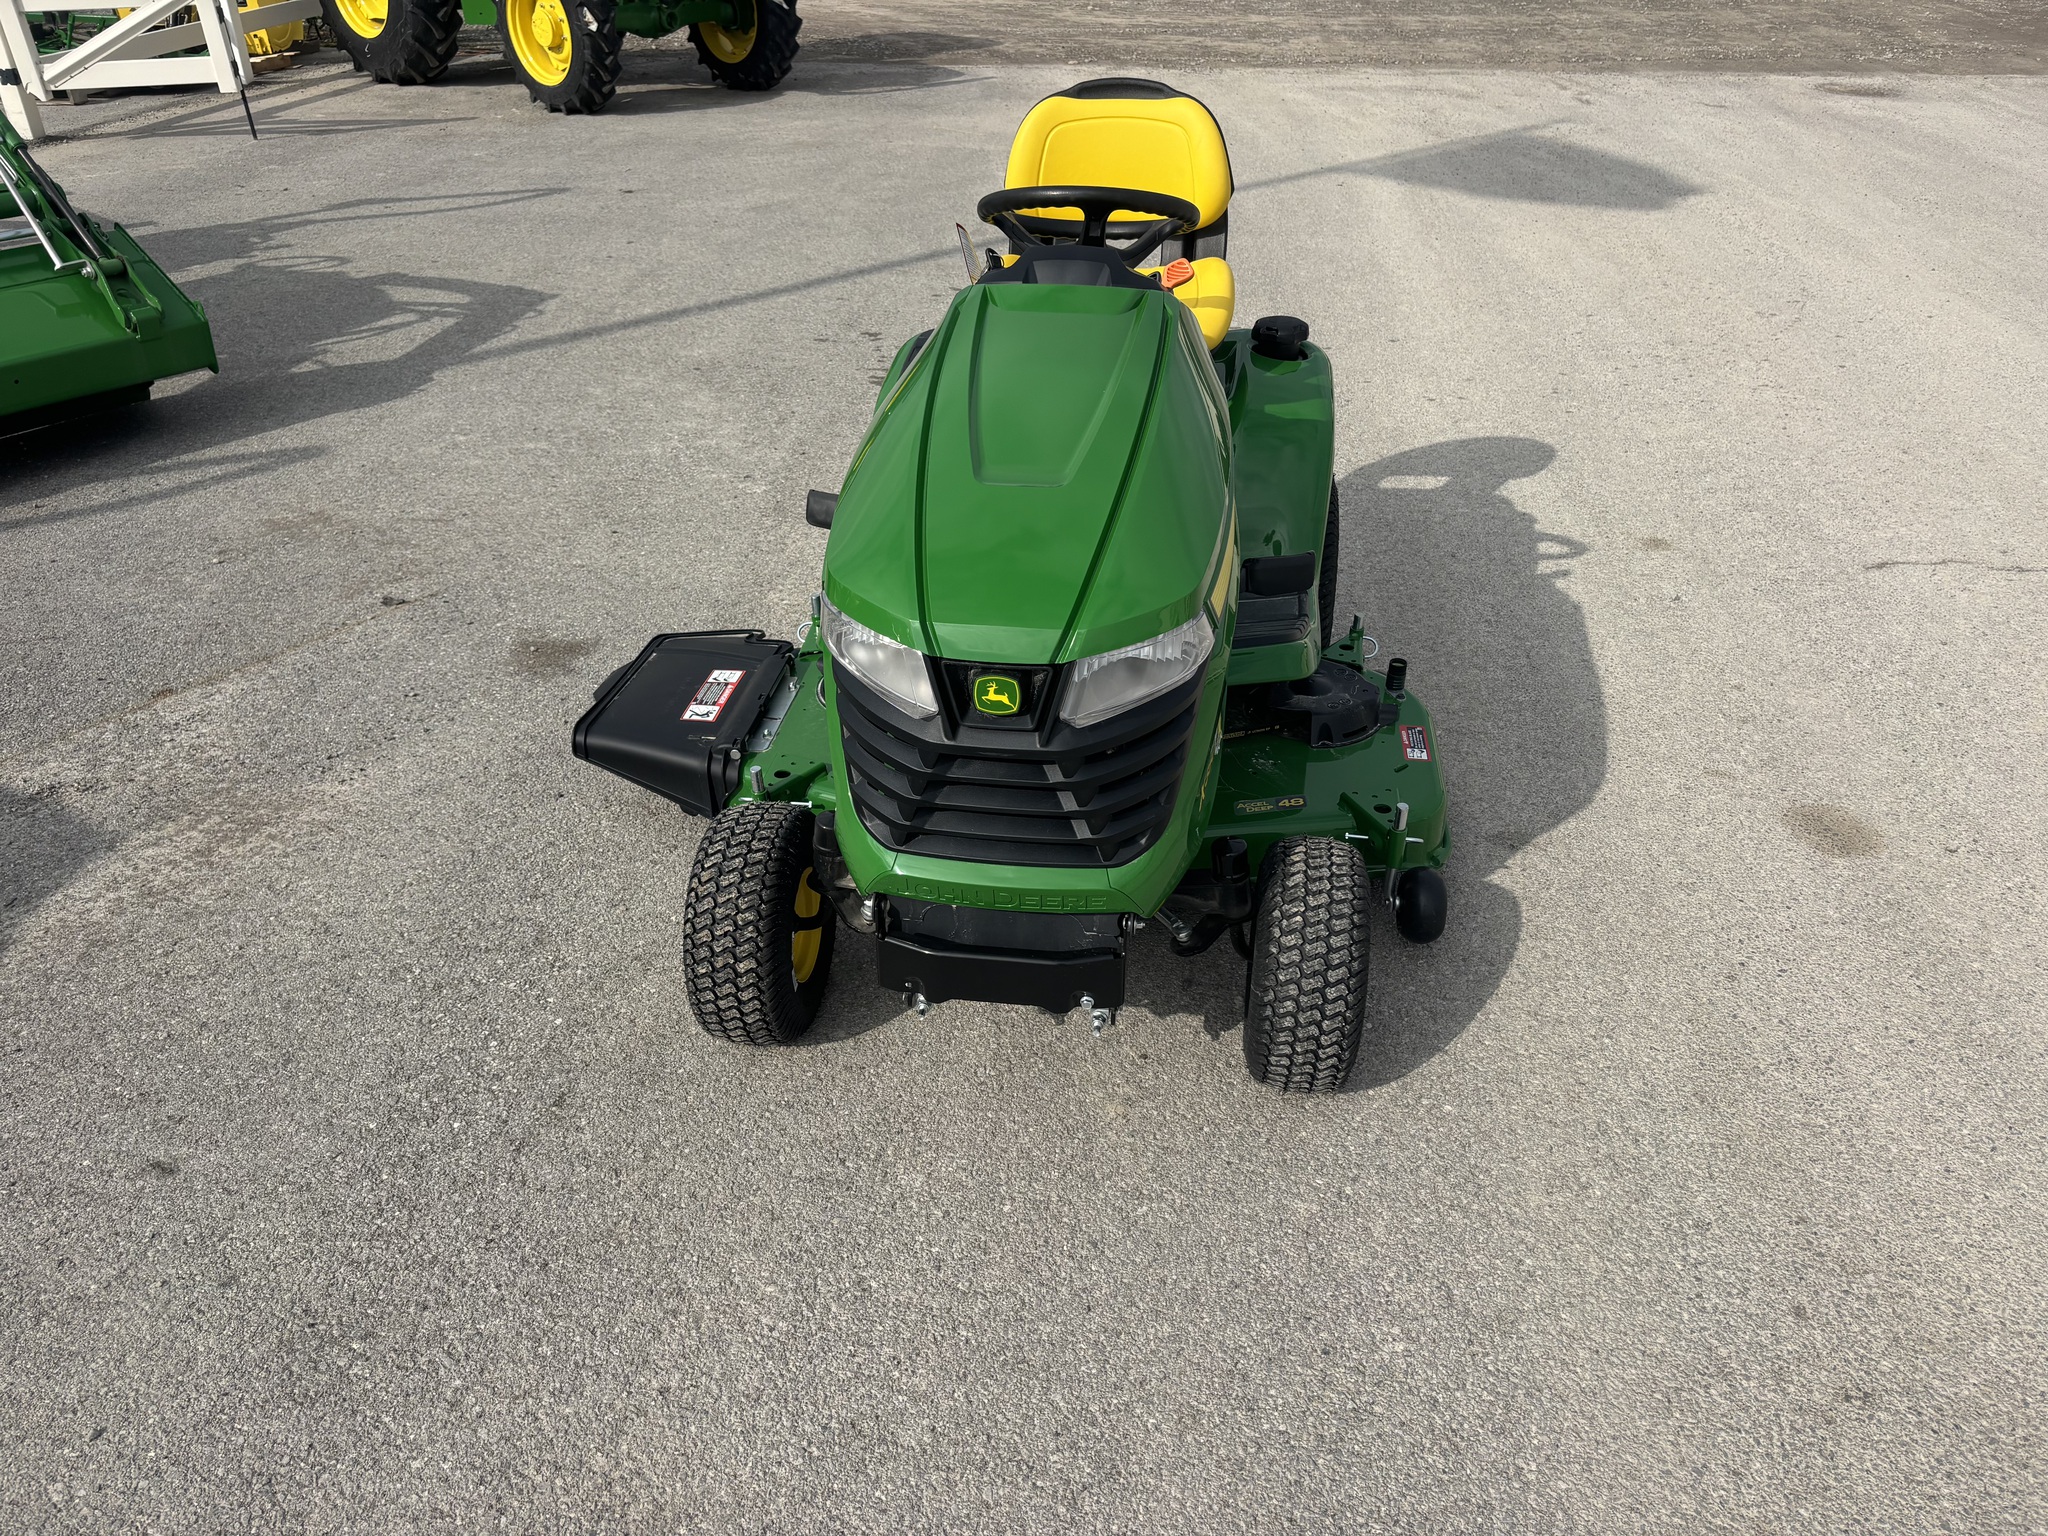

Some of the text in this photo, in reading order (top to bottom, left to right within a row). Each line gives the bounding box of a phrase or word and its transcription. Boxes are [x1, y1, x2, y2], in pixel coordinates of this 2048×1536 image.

[1237, 801, 1269, 809] ACCEL
[1278, 798, 1305, 807] 48
[1246, 805, 1274, 813] DEEP
[898, 878, 1107, 910] JOHN DEERE
